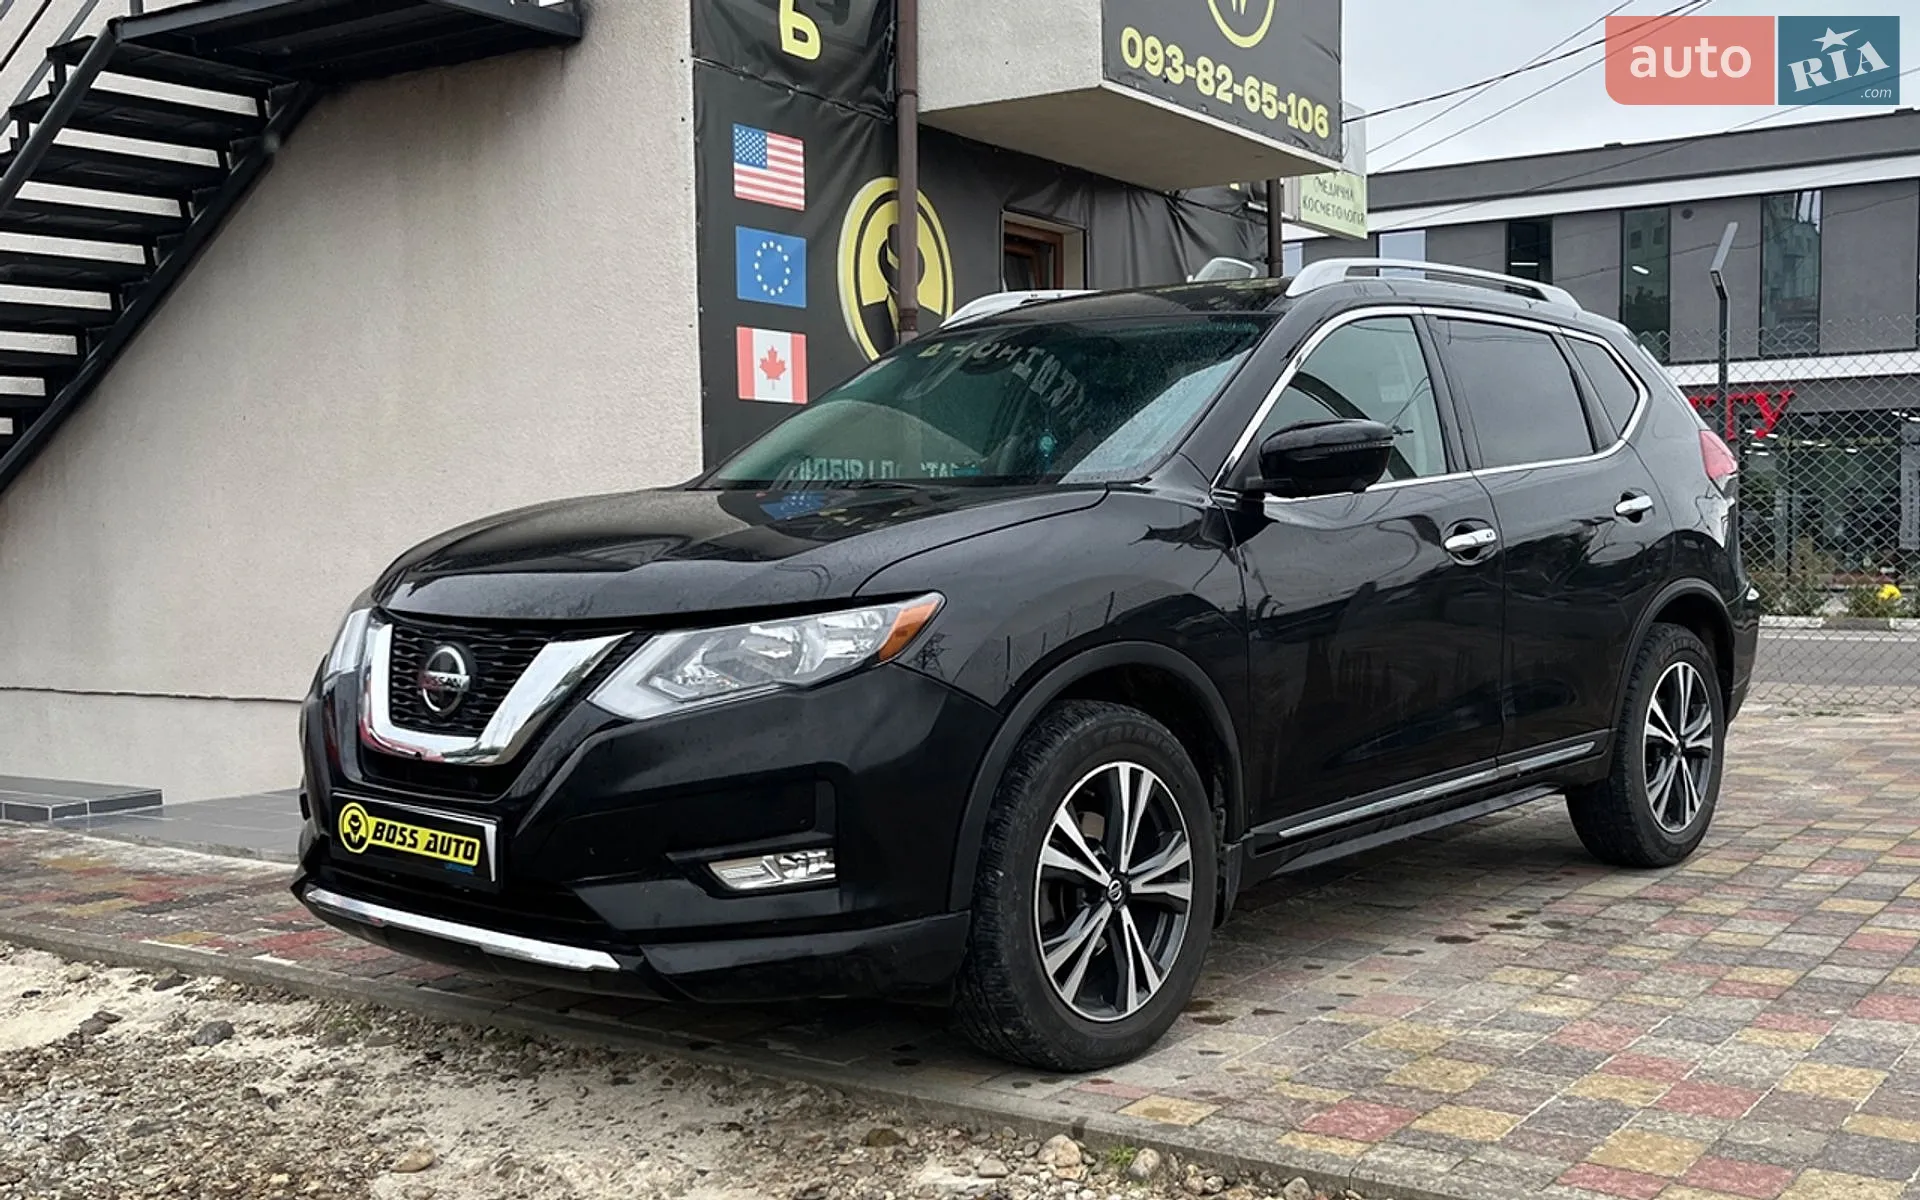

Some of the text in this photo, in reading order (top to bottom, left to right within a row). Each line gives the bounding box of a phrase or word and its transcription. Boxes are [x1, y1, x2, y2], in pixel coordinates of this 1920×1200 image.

[1121, 27, 1329, 138] 093-82-65-106
[372, 821, 477, 861] BOSS AUTO
